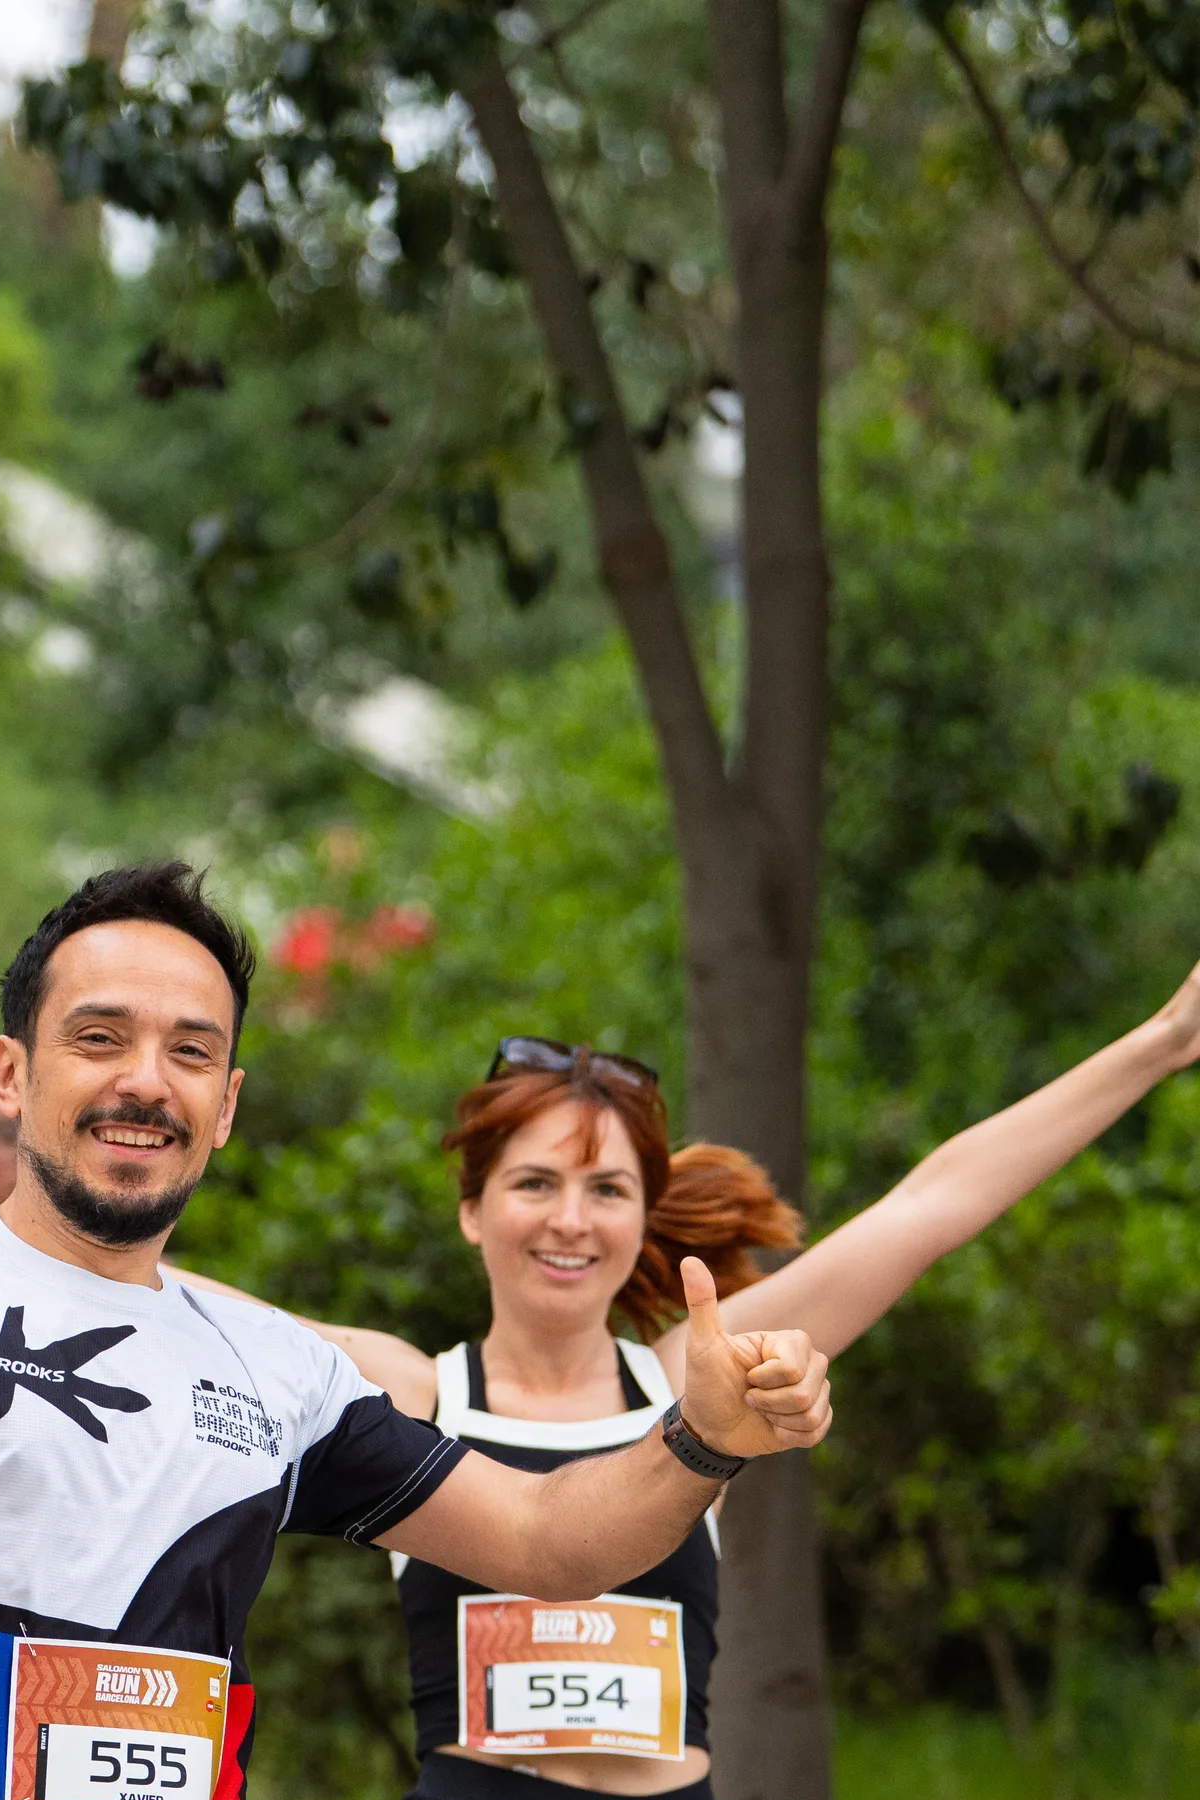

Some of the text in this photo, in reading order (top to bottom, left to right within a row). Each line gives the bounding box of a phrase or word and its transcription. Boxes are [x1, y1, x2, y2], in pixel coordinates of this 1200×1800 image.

[191, 1390, 243, 1421] MITJA
[206, 1433, 252, 1457] BROOKS
[96, 1663, 141, 1675] SALOMON
[95, 1673, 141, 1695] RUN
[528, 1674, 631, 1710] 554
[95, 1692, 141, 1705] BARCELONA
[89, 1740, 188, 1789] 555
